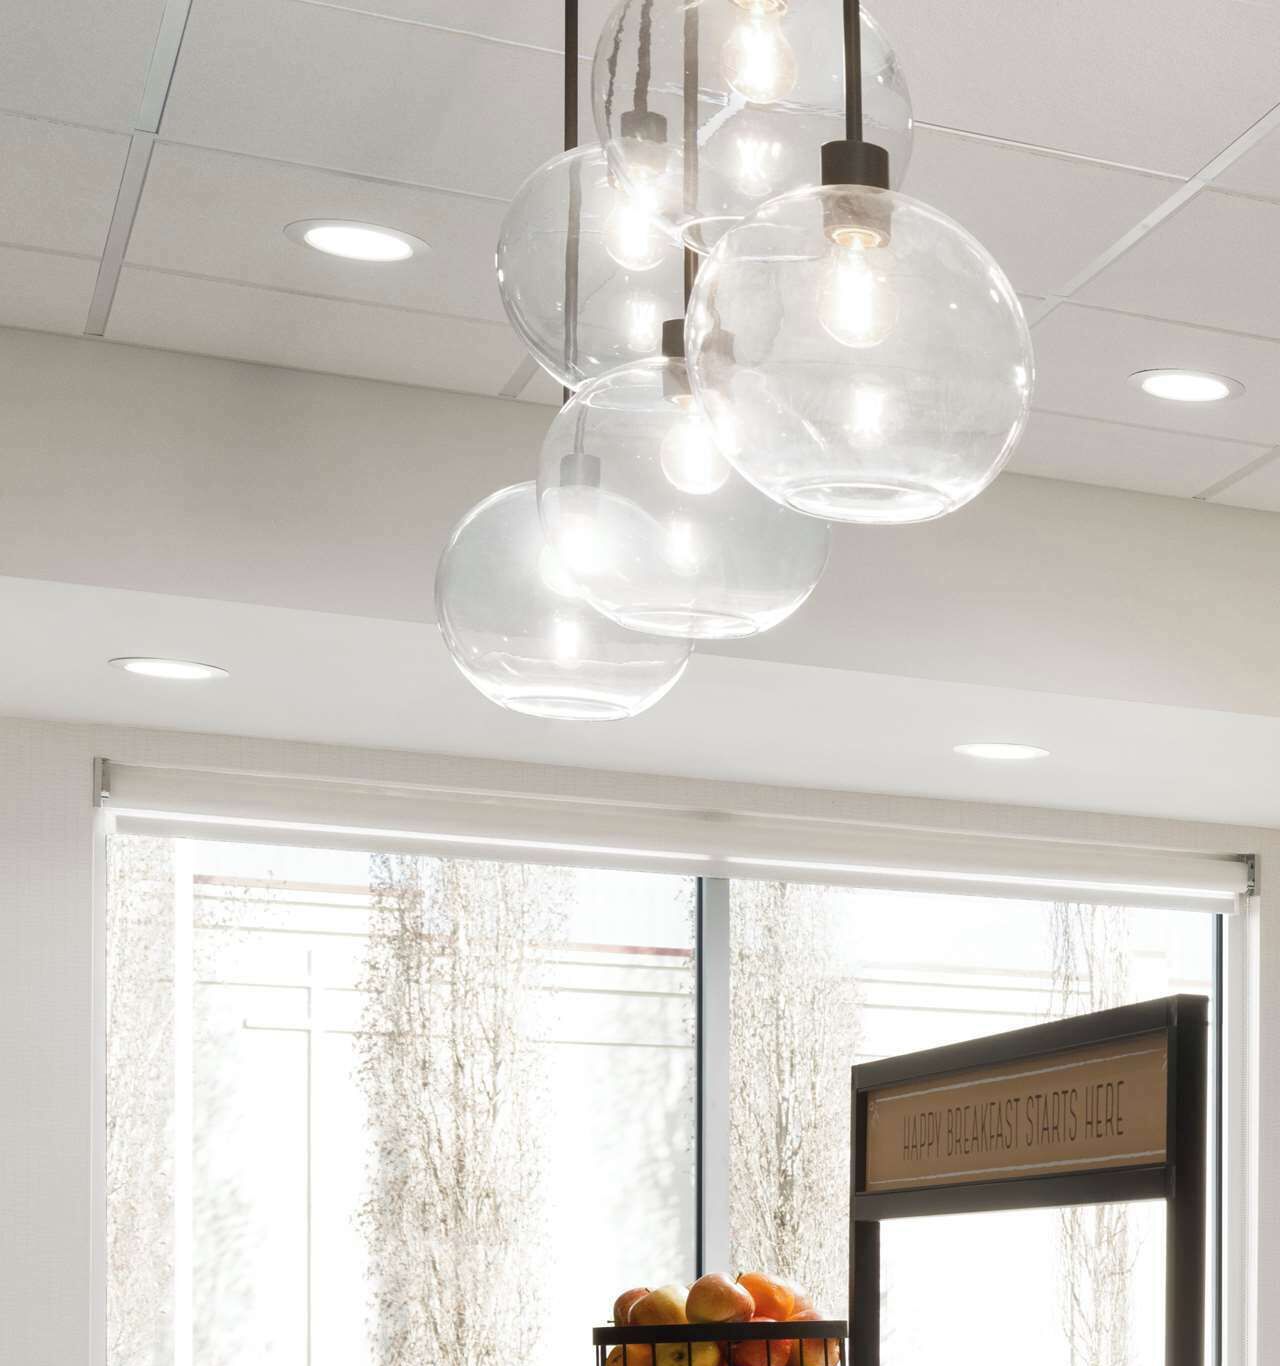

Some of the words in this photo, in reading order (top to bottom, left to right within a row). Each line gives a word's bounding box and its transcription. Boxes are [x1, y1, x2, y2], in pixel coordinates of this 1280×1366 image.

[903, 1111, 942, 1160] HAPPY
[947, 1098, 1021, 1157] BREAKFAST
[1025, 1088, 1078, 1147] STARTS
[1085, 1080, 1125, 1138] HERE
